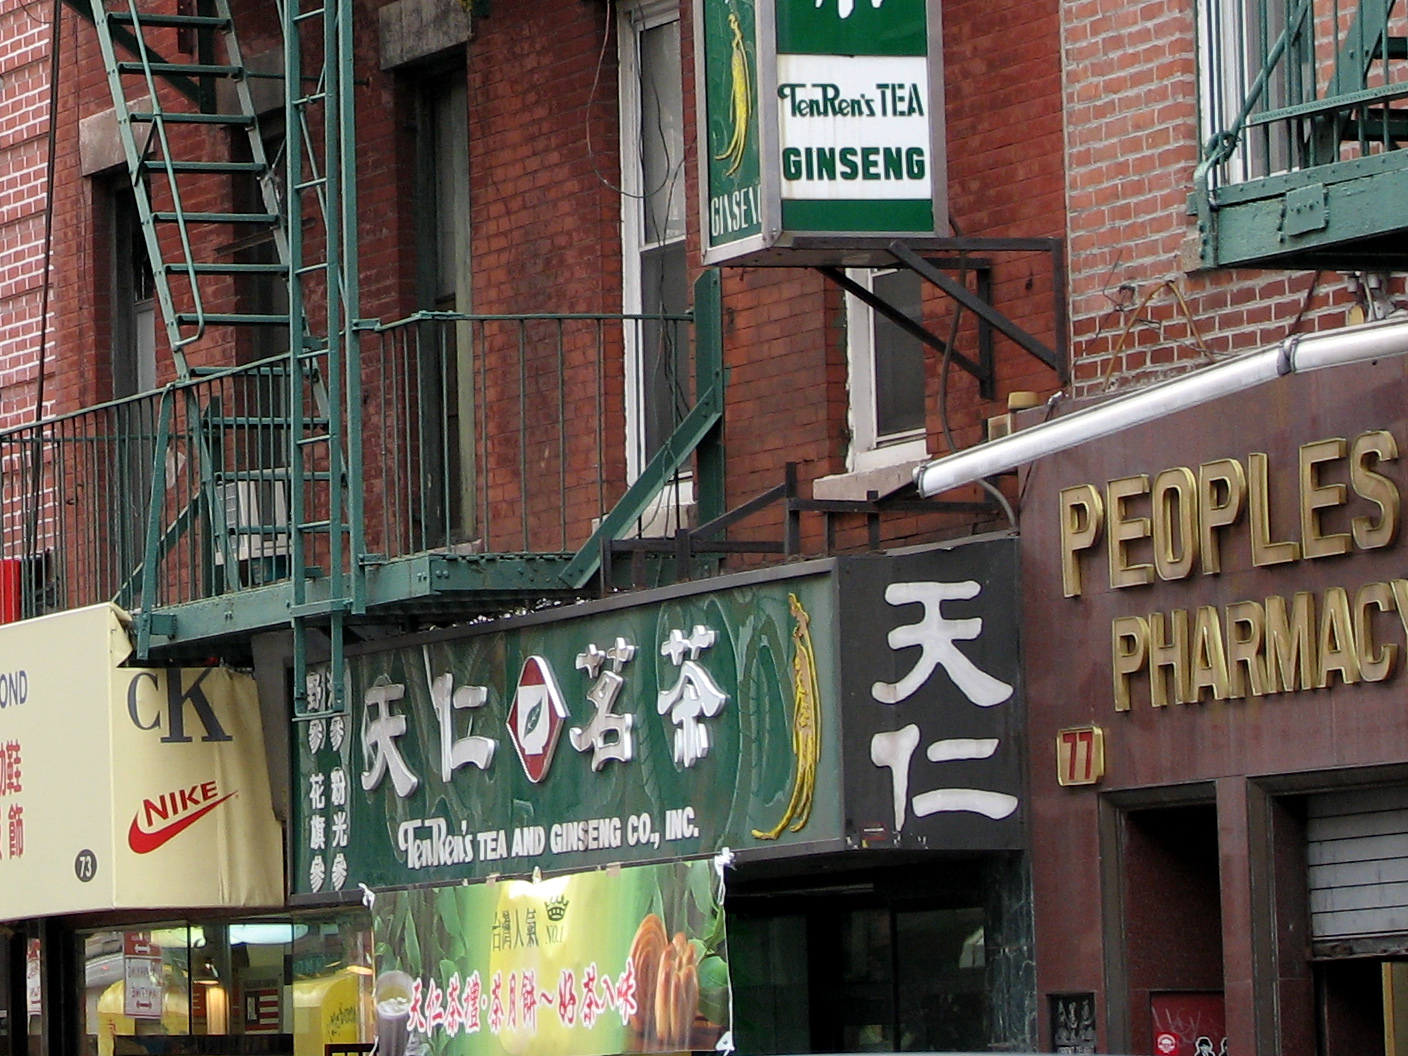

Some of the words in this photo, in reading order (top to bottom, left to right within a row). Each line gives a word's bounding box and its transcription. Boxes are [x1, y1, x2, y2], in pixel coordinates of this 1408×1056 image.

[876, 83, 925, 117] TEA
[782, 147, 926, 181] GINSENG
[1058, 430, 1401, 598] PEOPLES
[360, 673, 497, 798] 天仁
[569, 625, 729, 772] 茗茶
[871, 580, 1019, 832] 天仁
[1062, 732, 1092, 781] 77
[143, 781, 219, 827] NIKE
[478, 831, 508, 861] TEA
[512, 826, 546, 857] AND
[550, 818, 621, 854] GINSENG
[665, 806, 700, 840] INC.
[79, 855, 92, 876] 73
